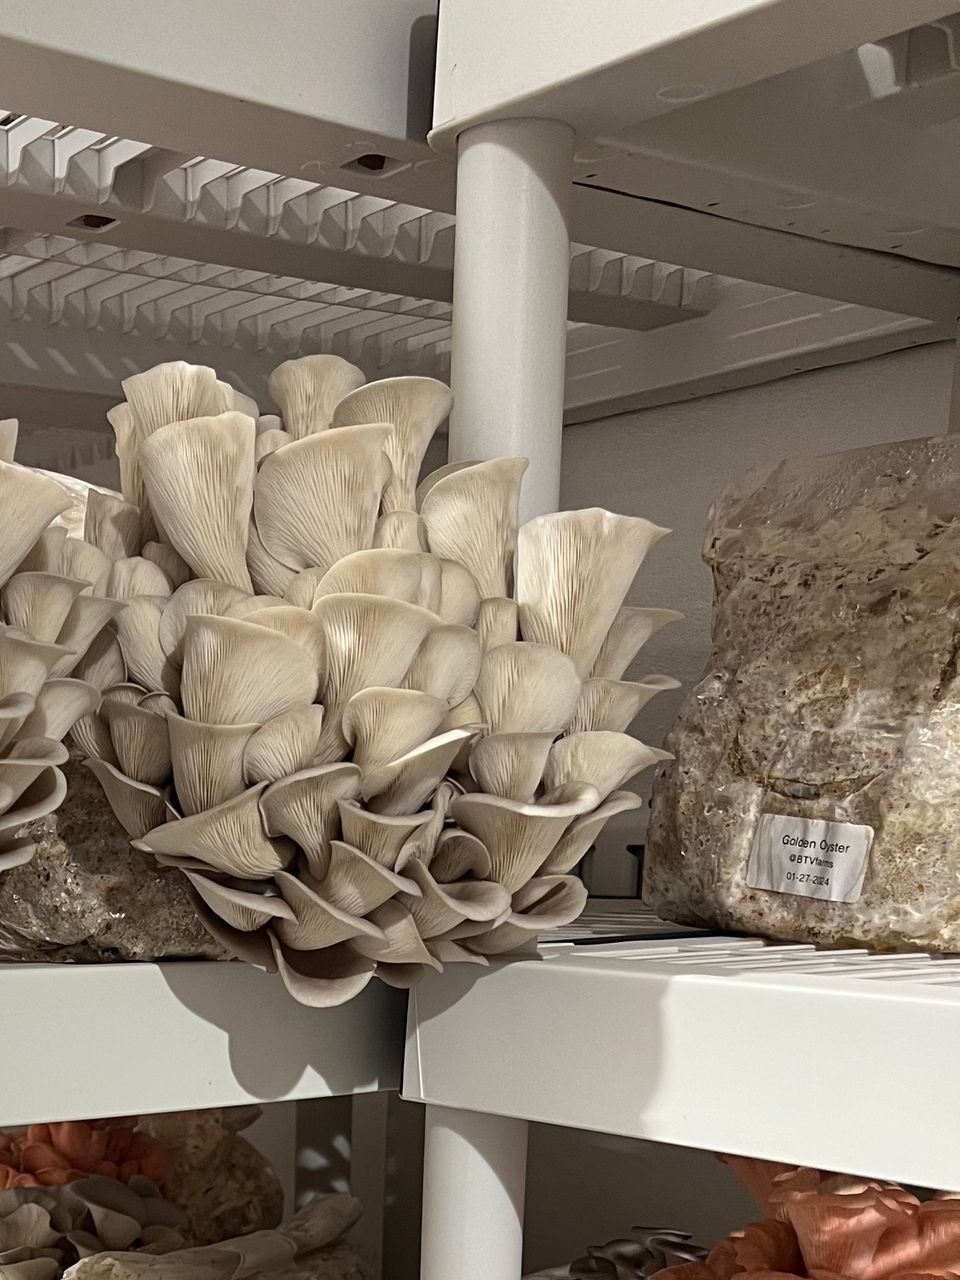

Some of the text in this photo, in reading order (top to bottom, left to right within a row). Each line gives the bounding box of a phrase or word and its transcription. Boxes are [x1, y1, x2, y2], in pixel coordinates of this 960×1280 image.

[782, 834, 851, 854] Golden Oyster
[786, 871, 830, 886] 01-27-2024
